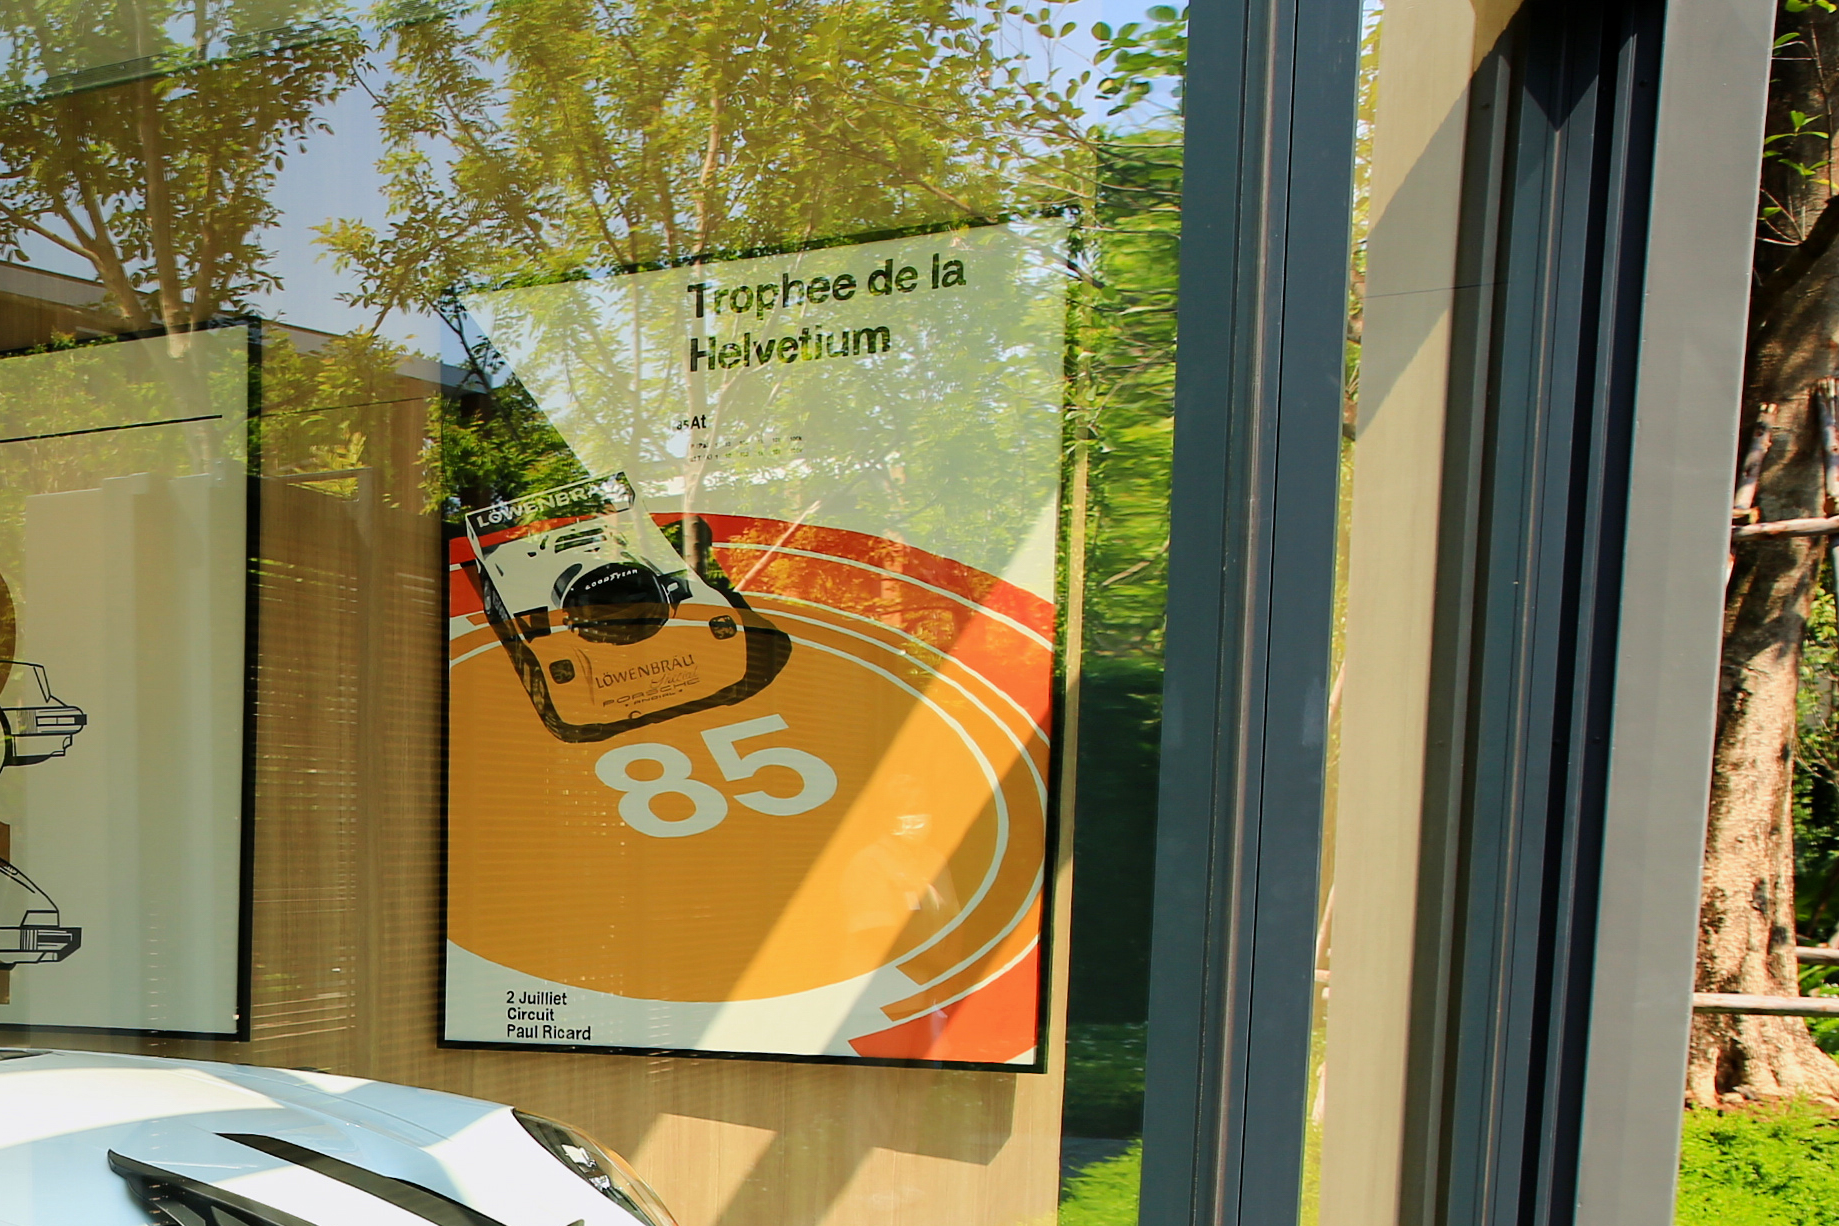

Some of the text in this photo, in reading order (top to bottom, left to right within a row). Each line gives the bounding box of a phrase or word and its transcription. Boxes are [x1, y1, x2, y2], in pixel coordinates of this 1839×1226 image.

[687, 253, 967, 321] Trophee de la
[690, 324, 891, 372] Helvetium
[595, 654, 695, 689] LÖWENBRÄU
[594, 713, 837, 838] 85
[506, 990, 567, 1006] 2 Juilliet
[507, 1006, 555, 1021] Circuit
[507, 1023, 591, 1041] Paul Ricard
